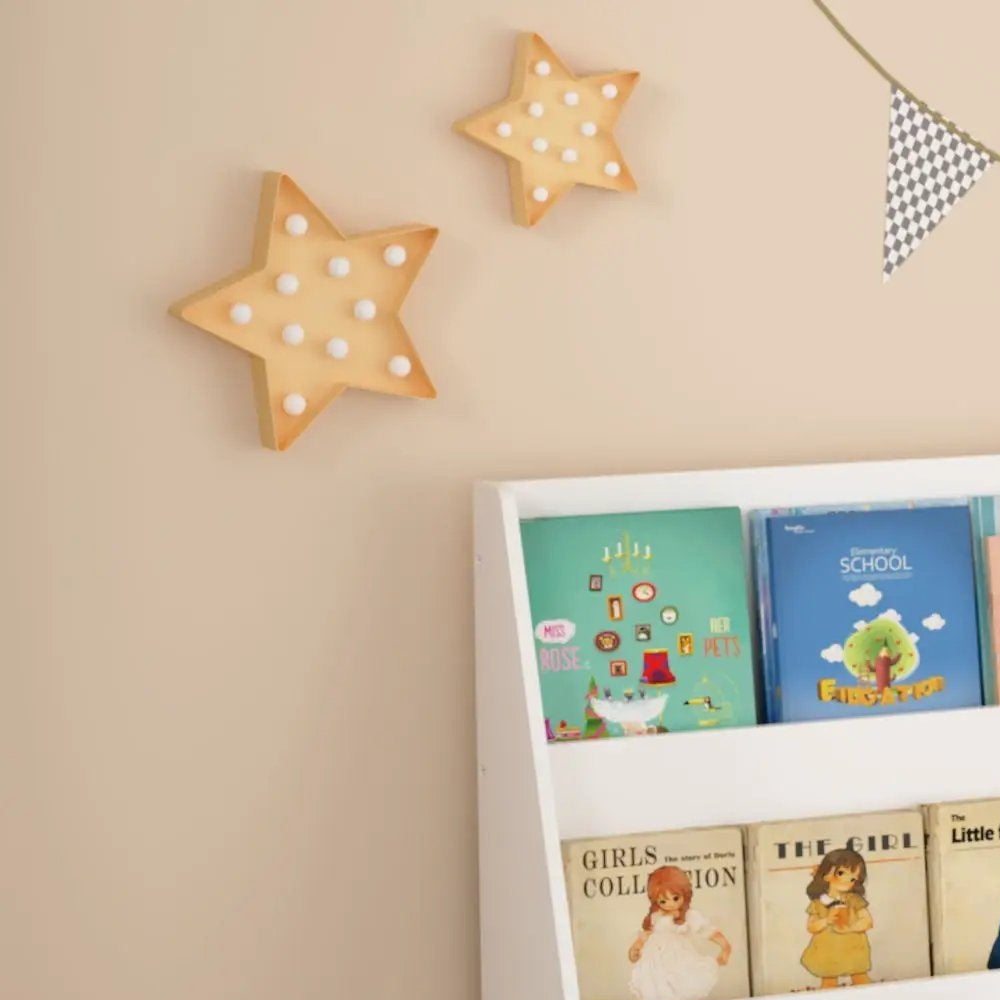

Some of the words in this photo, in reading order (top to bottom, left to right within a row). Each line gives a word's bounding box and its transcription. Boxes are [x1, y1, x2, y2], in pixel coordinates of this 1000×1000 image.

[840, 555, 913, 574] SCHOOL
[704, 636, 741, 658] PETS
[541, 646, 582, 671] ROSE
[951, 814, 966, 822] The
[846, 832, 918, 852] GIRL
[952, 825, 995, 843] Little
[582, 845, 657, 871] GIRLS
[583, 866, 737, 899] COLLION
